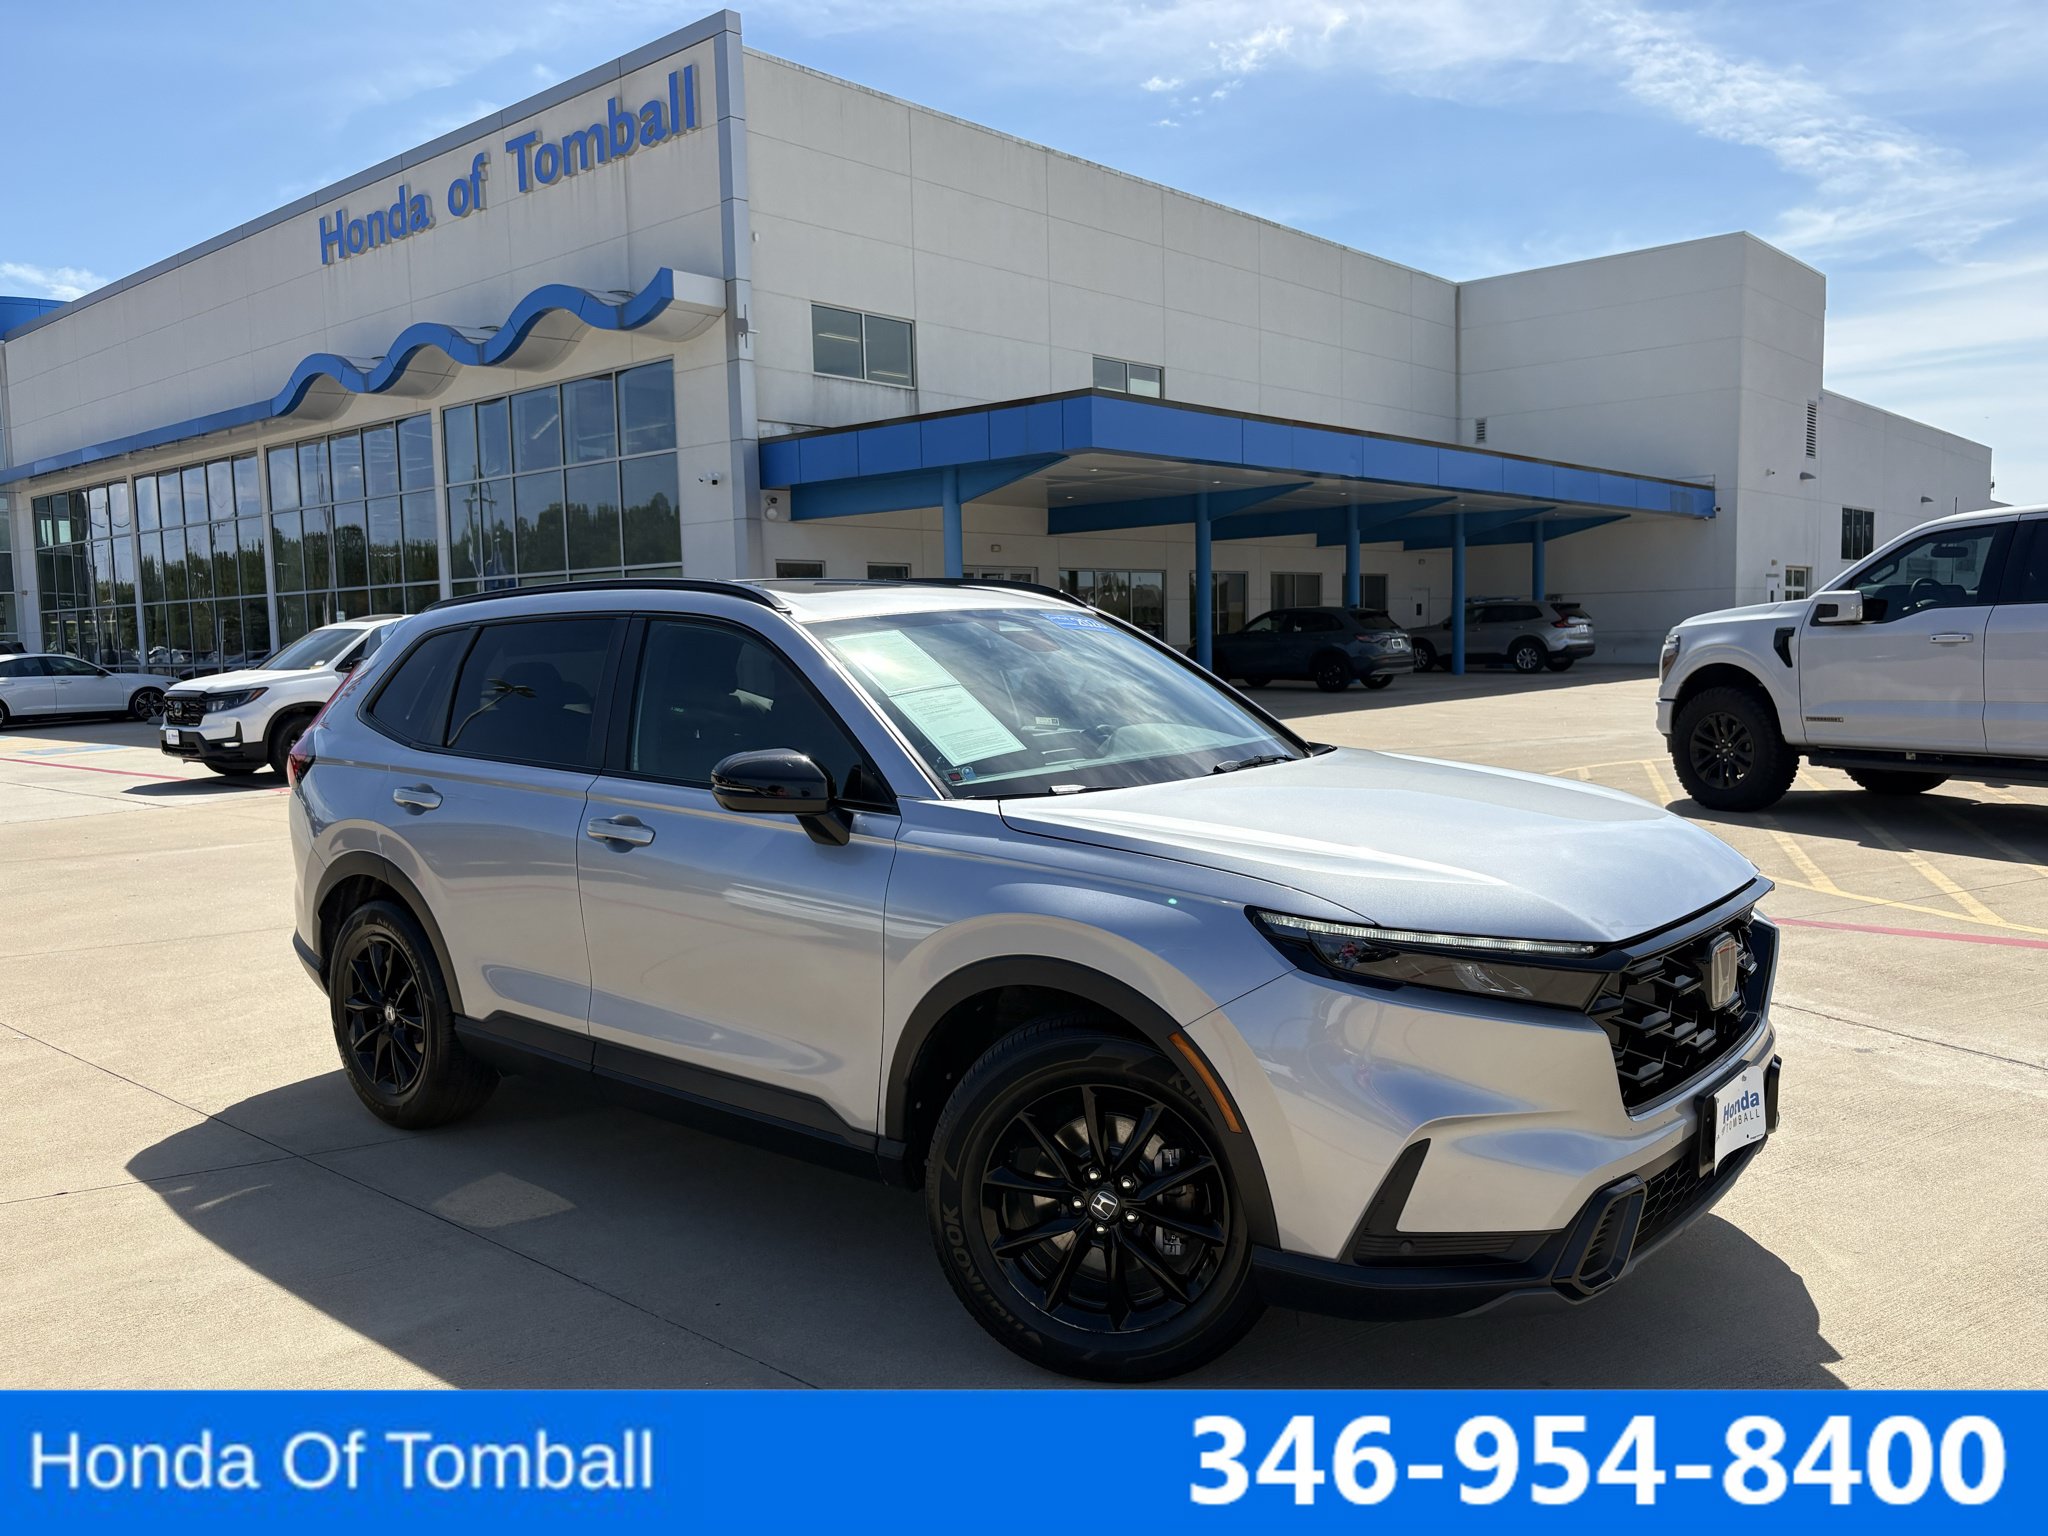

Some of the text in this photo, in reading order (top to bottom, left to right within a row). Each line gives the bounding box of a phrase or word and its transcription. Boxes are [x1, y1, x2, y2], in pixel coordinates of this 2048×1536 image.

[319, 64, 700, 265] Honda of Tomball
[1723, 1090, 1760, 1125] Honda
[1726, 1109, 1760, 1133] TOMBALL
